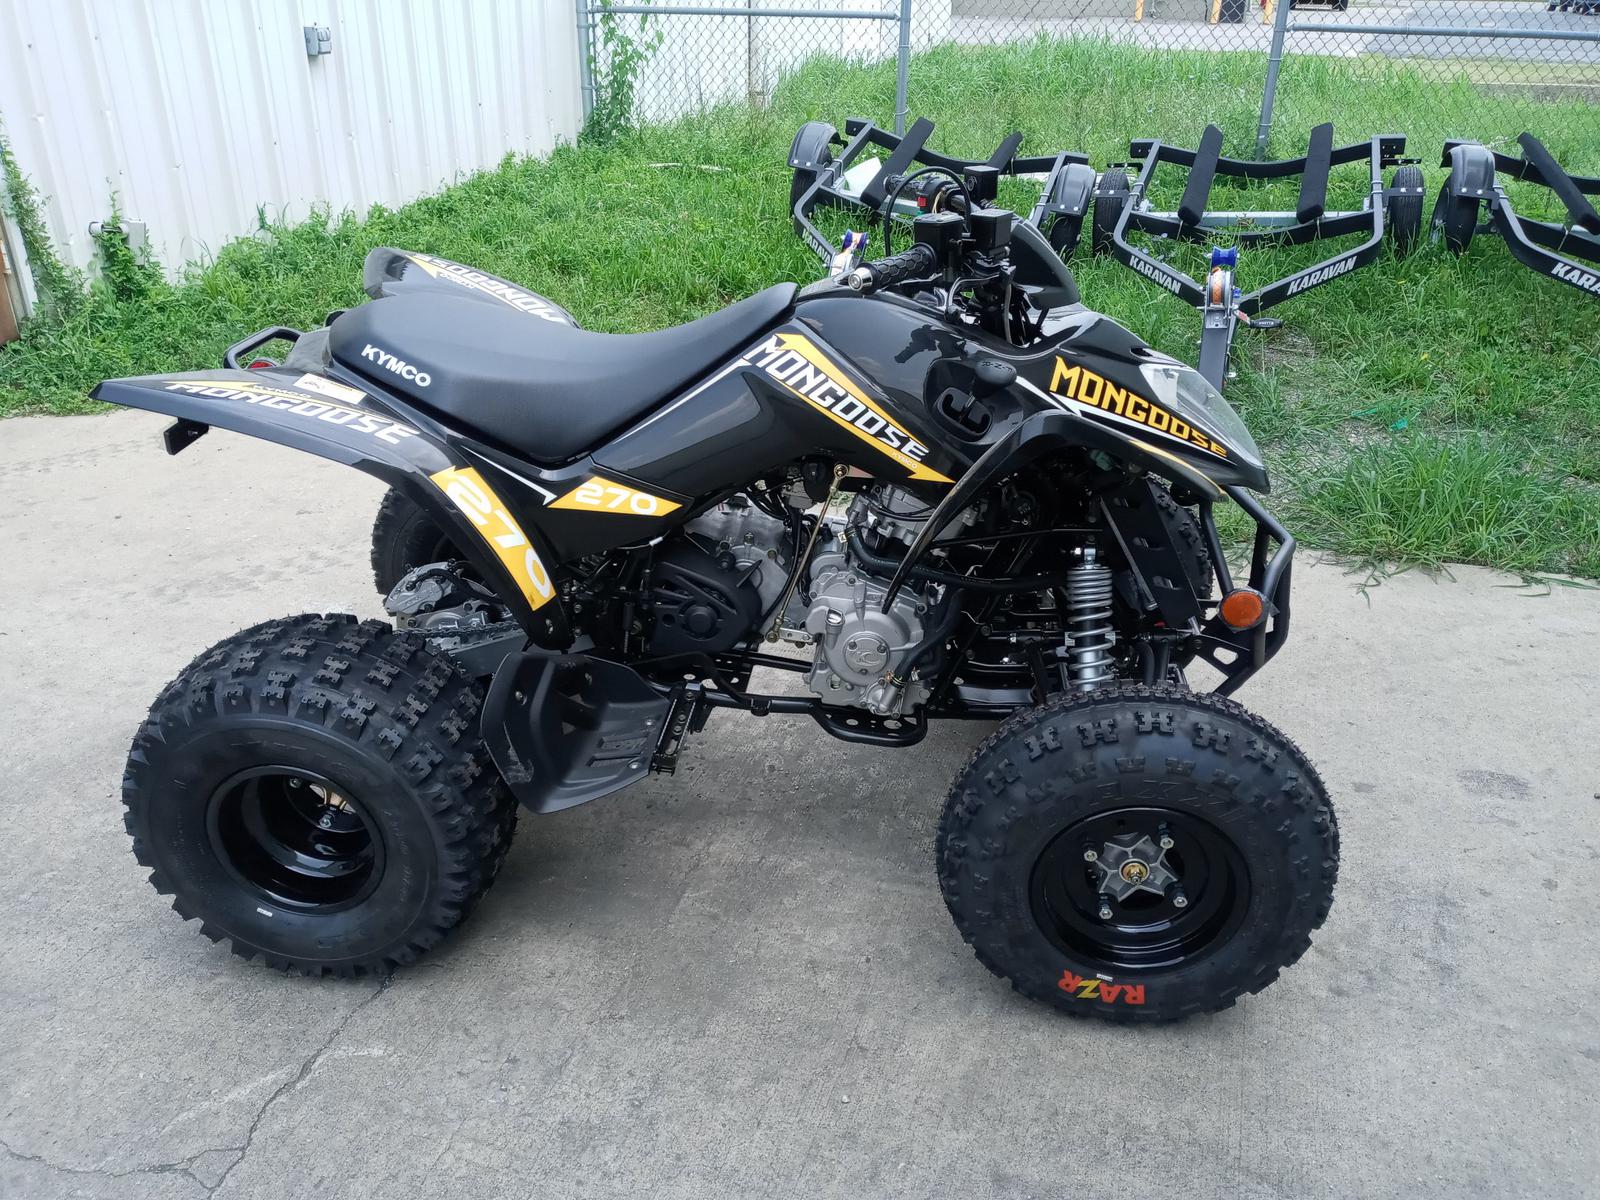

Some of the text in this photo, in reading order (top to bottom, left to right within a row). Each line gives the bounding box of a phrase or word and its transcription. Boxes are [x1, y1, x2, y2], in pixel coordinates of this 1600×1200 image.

[802, 228, 832, 267] KARAVA
[1129, 255, 1181, 294] KARAVAN
[1286, 256, 1357, 296] KARAVAN
[361, 344, 431, 387] KYMCO
[165, 384, 420, 445] MONGOOSE
[743, 335, 930, 462] MONGOOSE
[1049, 354, 1228, 458] MONGOOSE
[892, 452, 919, 469] KYMCO
[575, 482, 657, 516] 270
[446, 474, 551, 598] 270
[1058, 969, 1145, 1005] RAZR
